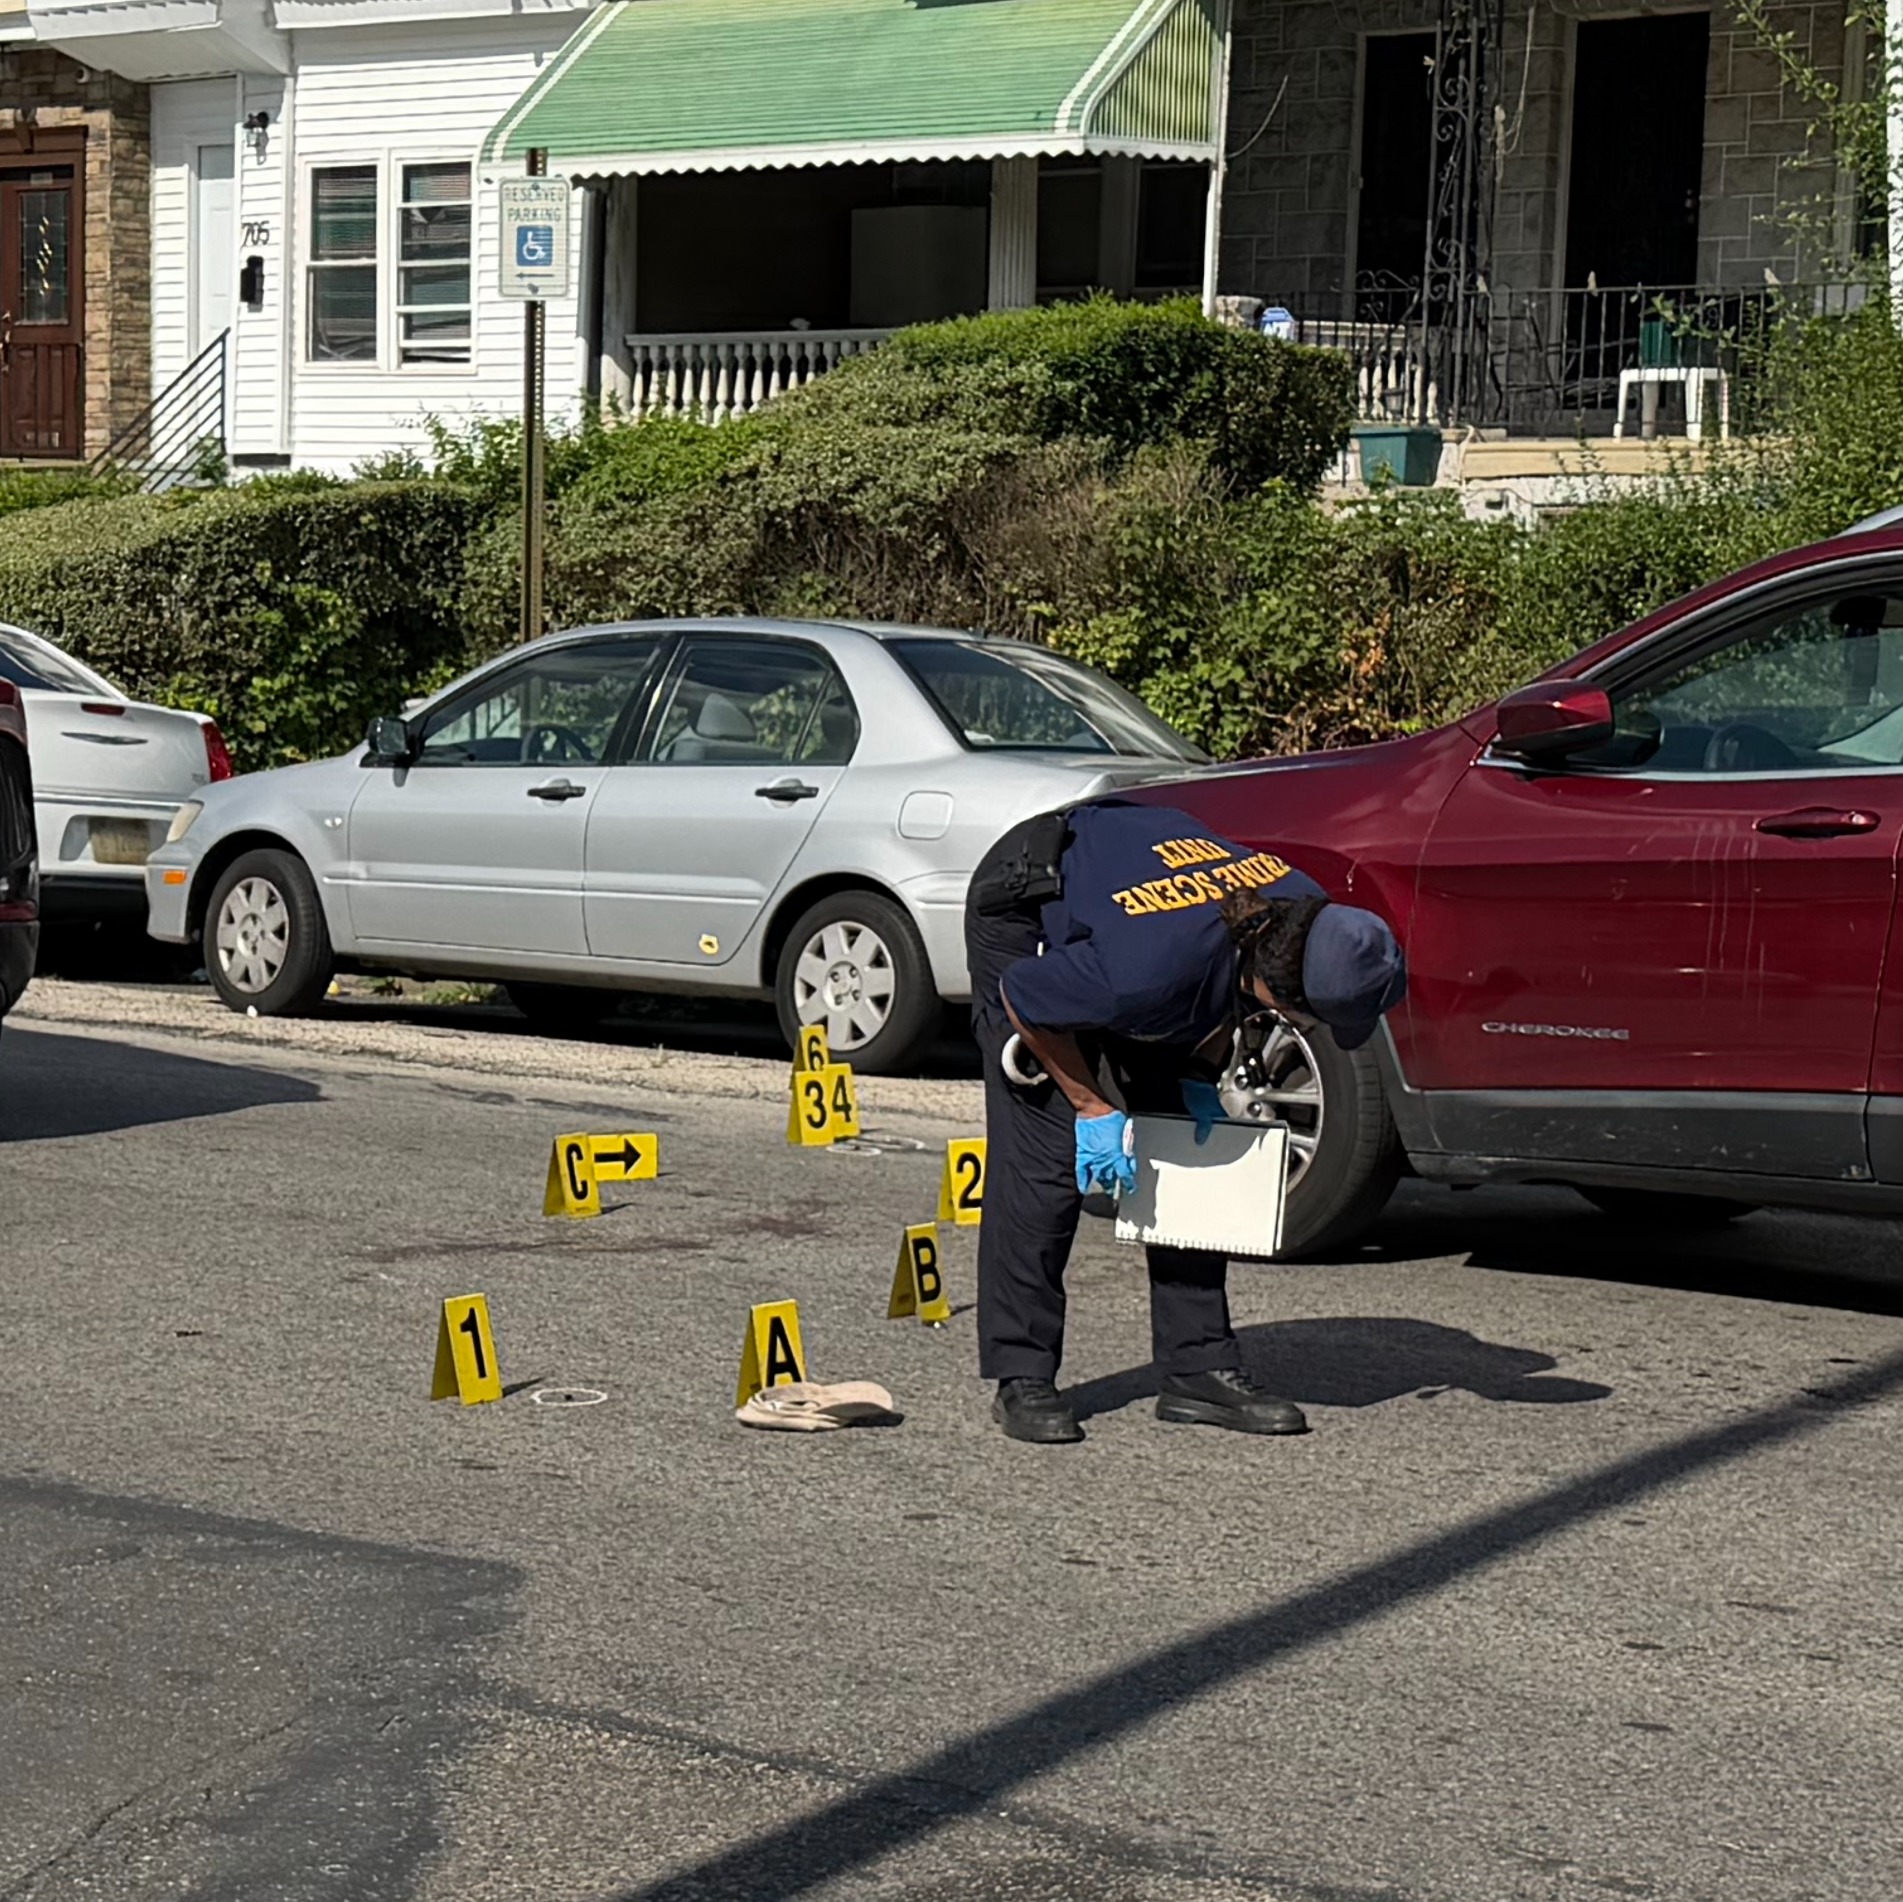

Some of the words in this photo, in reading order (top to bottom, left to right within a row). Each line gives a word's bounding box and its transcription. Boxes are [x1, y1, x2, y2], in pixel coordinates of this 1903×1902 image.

[504, 187, 564, 201] RESERVED
[508, 207, 560, 221] PARKING
[241, 220, 269, 247] 705
[1152, 837, 1231, 869] UNIT
[1112, 871, 1224, 916] SCENE
[807, 1035, 824, 1071] 6
[1481, 1021, 1630, 1040] CHEROKEE
[805, 1080, 827, 1129] 3
[832, 1075, 851, 1122] 4
[566, 1143, 588, 1200] C
[956, 1152, 982, 1209] 2
[912, 1237, 941, 1303] B
[460, 1307, 487, 1379] 1
[766, 1316, 802, 1387] A
